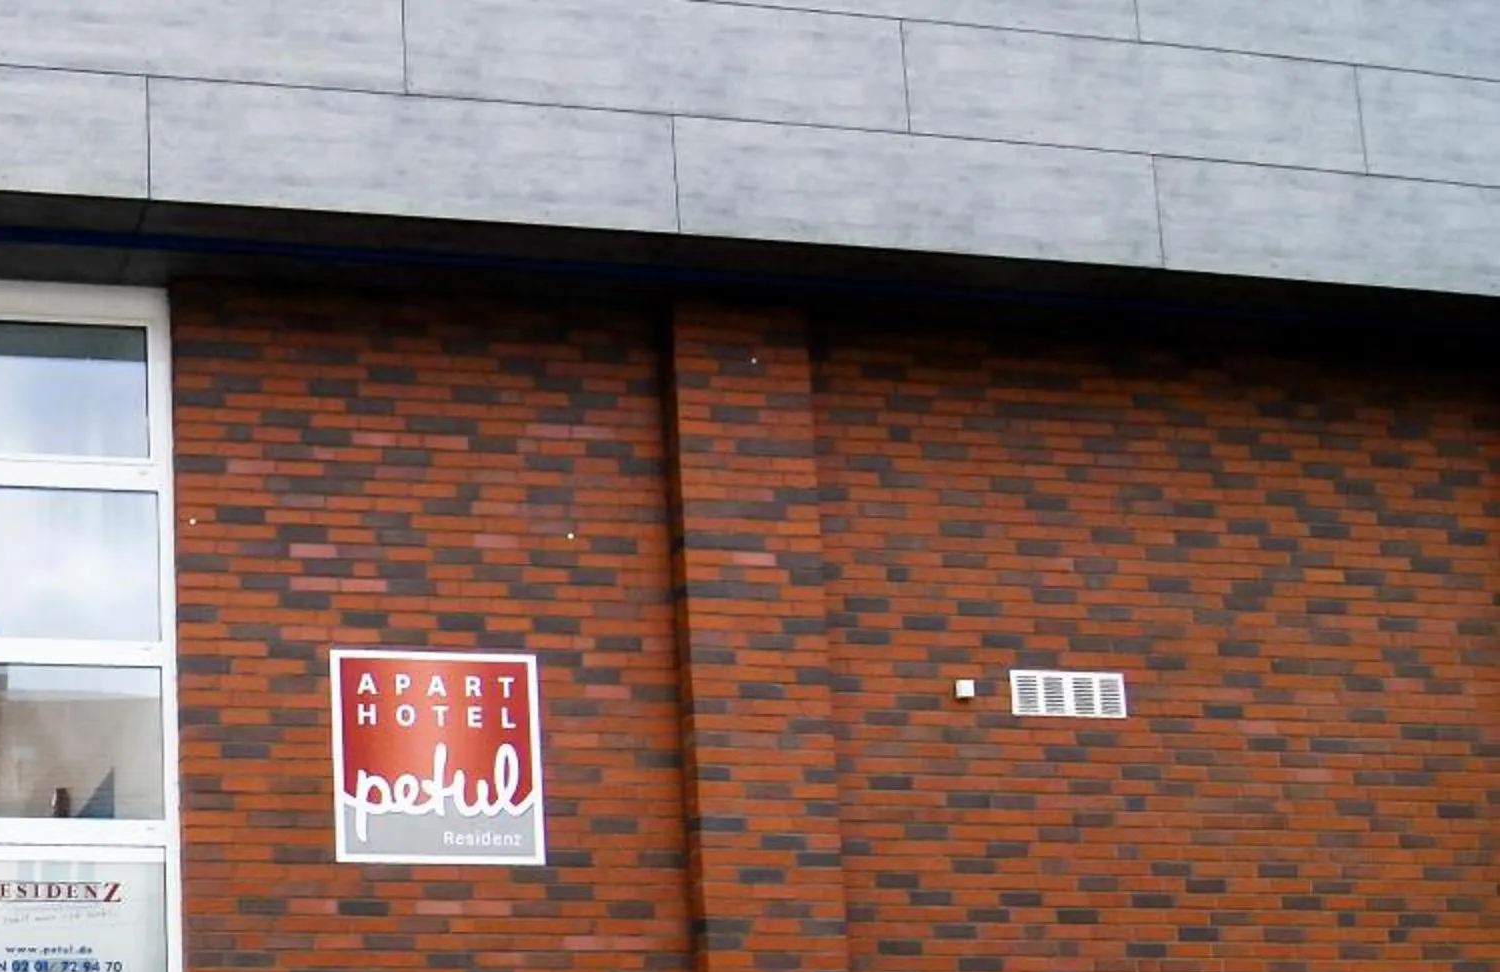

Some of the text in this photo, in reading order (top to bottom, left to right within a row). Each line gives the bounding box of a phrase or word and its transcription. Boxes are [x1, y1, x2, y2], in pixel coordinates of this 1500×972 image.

[357, 672, 515, 698] APART
[357, 703, 517, 729] HOTEL
[354, 742, 524, 842] petul
[443, 831, 523, 847] Residenz
[12, 960, 29, 972] 02
[60, 961, 77, 972] 72
[83, 961, 101, 972] 94
[106, 961, 123, 972] 70
